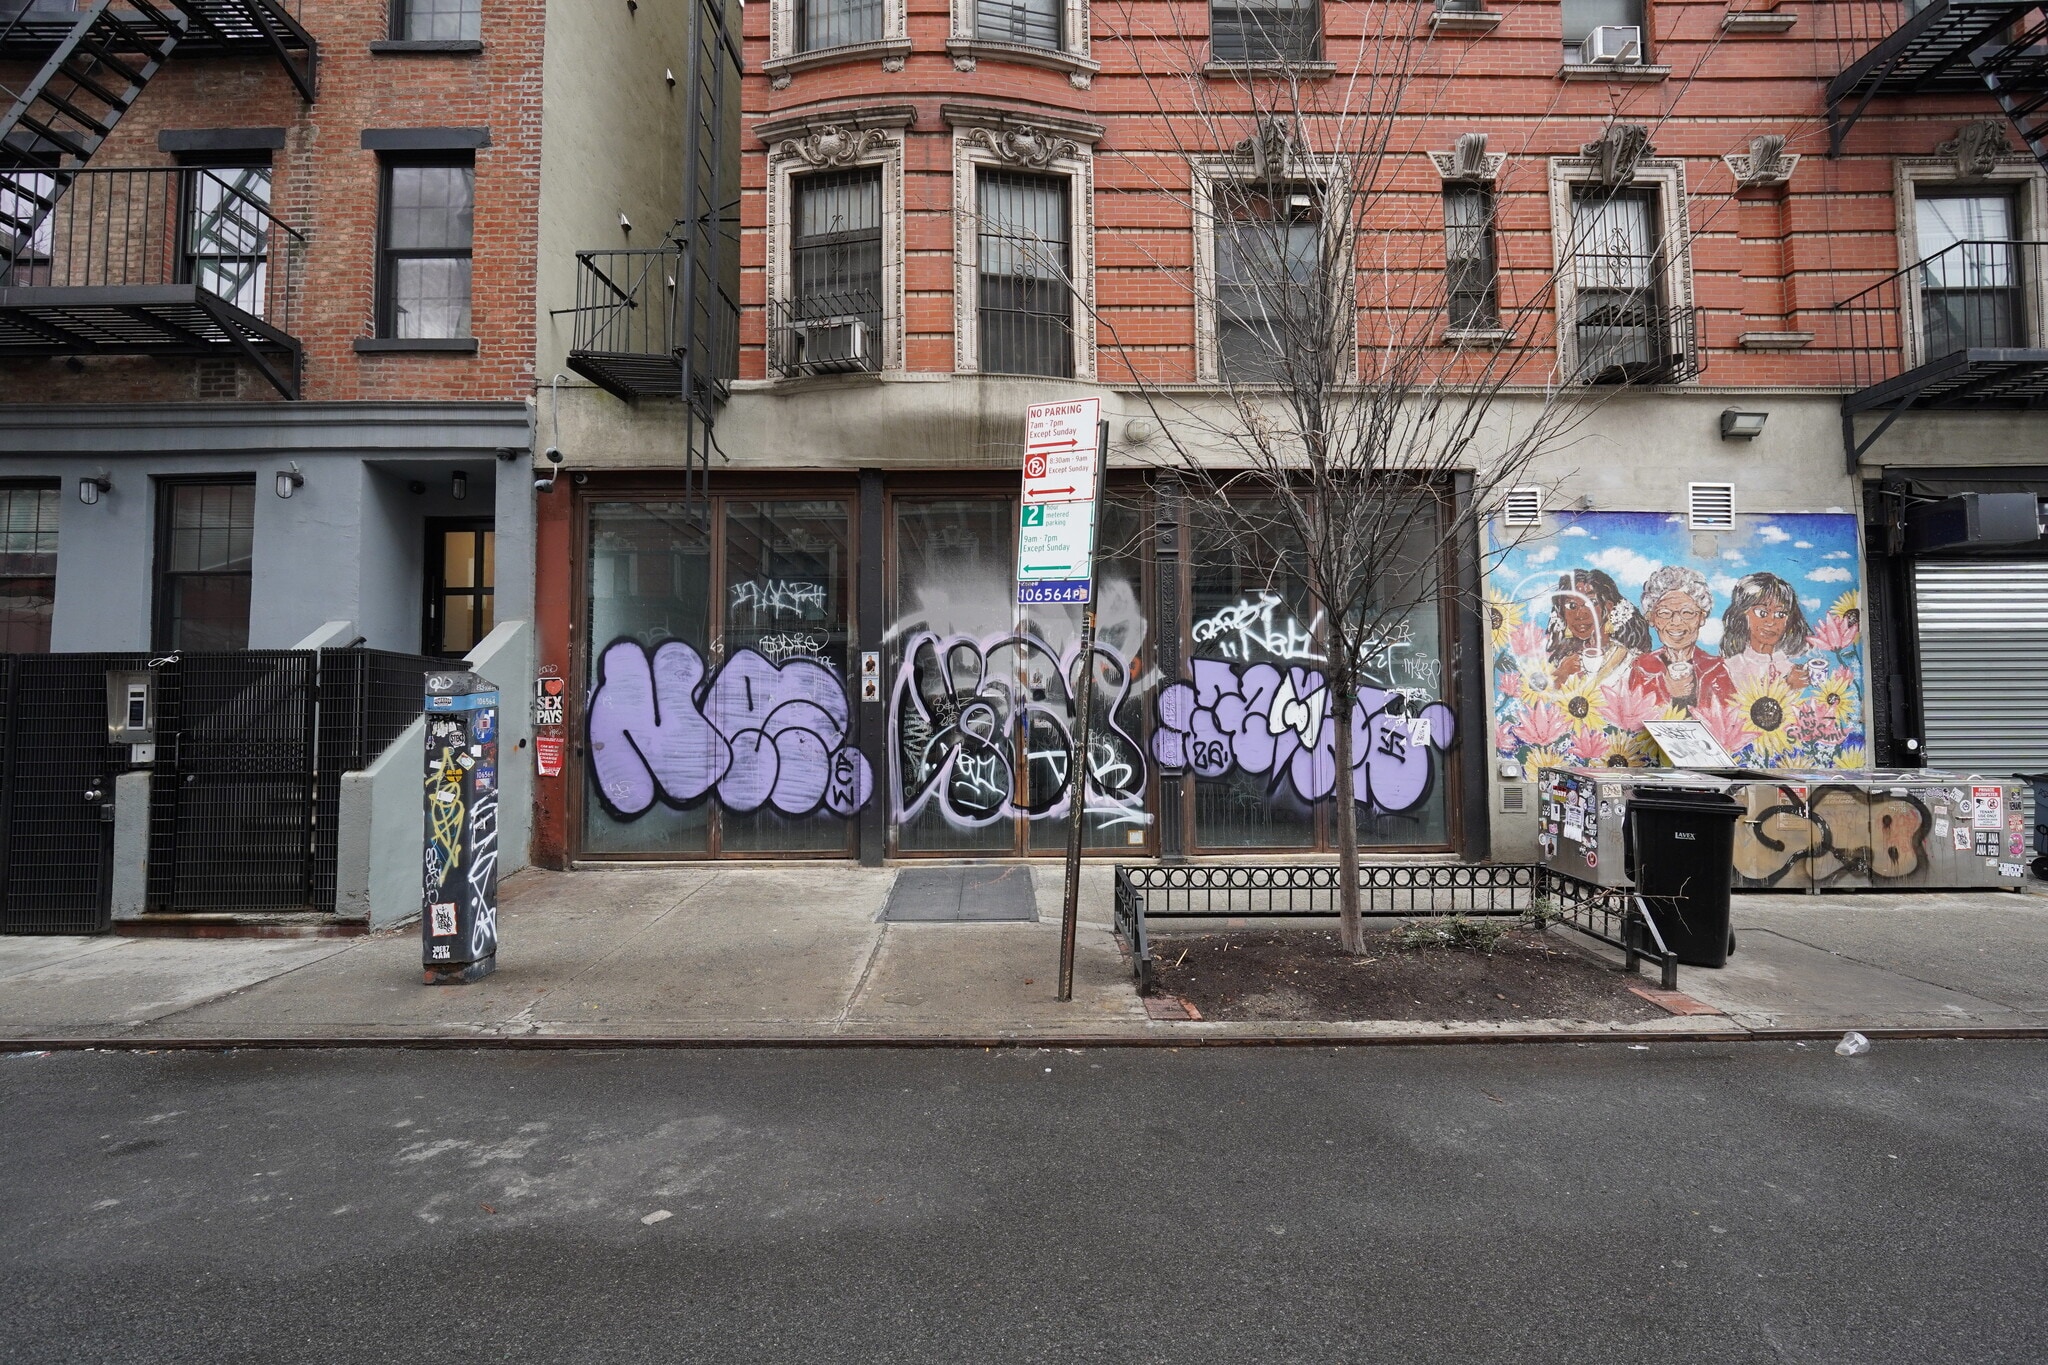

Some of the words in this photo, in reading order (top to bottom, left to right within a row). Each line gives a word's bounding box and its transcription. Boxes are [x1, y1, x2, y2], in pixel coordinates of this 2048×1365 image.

[1030, 409, 1042, 418] NO
[1045, 404, 1082, 417] PARKING
[1030, 421, 1044, 429] 7am
[1029, 430, 1051, 439] Except
[1053, 428, 1077, 438] Sunday
[1069, 465, 1089, 473] Sunday
[1027, 505, 1039, 525] 2
[1045, 519, 1066, 527] parking
[1024, 535, 1037, 543] 9am
[1044, 534, 1058, 543] 7pm
[1023, 544, 1045, 552] Except
[1046, 543, 1070, 552] Sunday
[1020, 588, 1071, 601] 106564
[537, 680, 542, 697] I
[536, 696, 562, 710] SEX
[536, 710, 563, 724] PAYS
[1799, 708, 1815, 719] Art
[1803, 719, 1816, 728] by
[1786, 726, 1814, 744] Sita
[1815, 722, 1847, 742] Sunil
[1674, 832, 1696, 841] LAVEX
[1976, 832, 1987, 843] PERU
[1988, 832, 1999, 844] ANA
[1976, 845, 1987, 855] ANA
[1988, 845, 1999, 855] PERU
